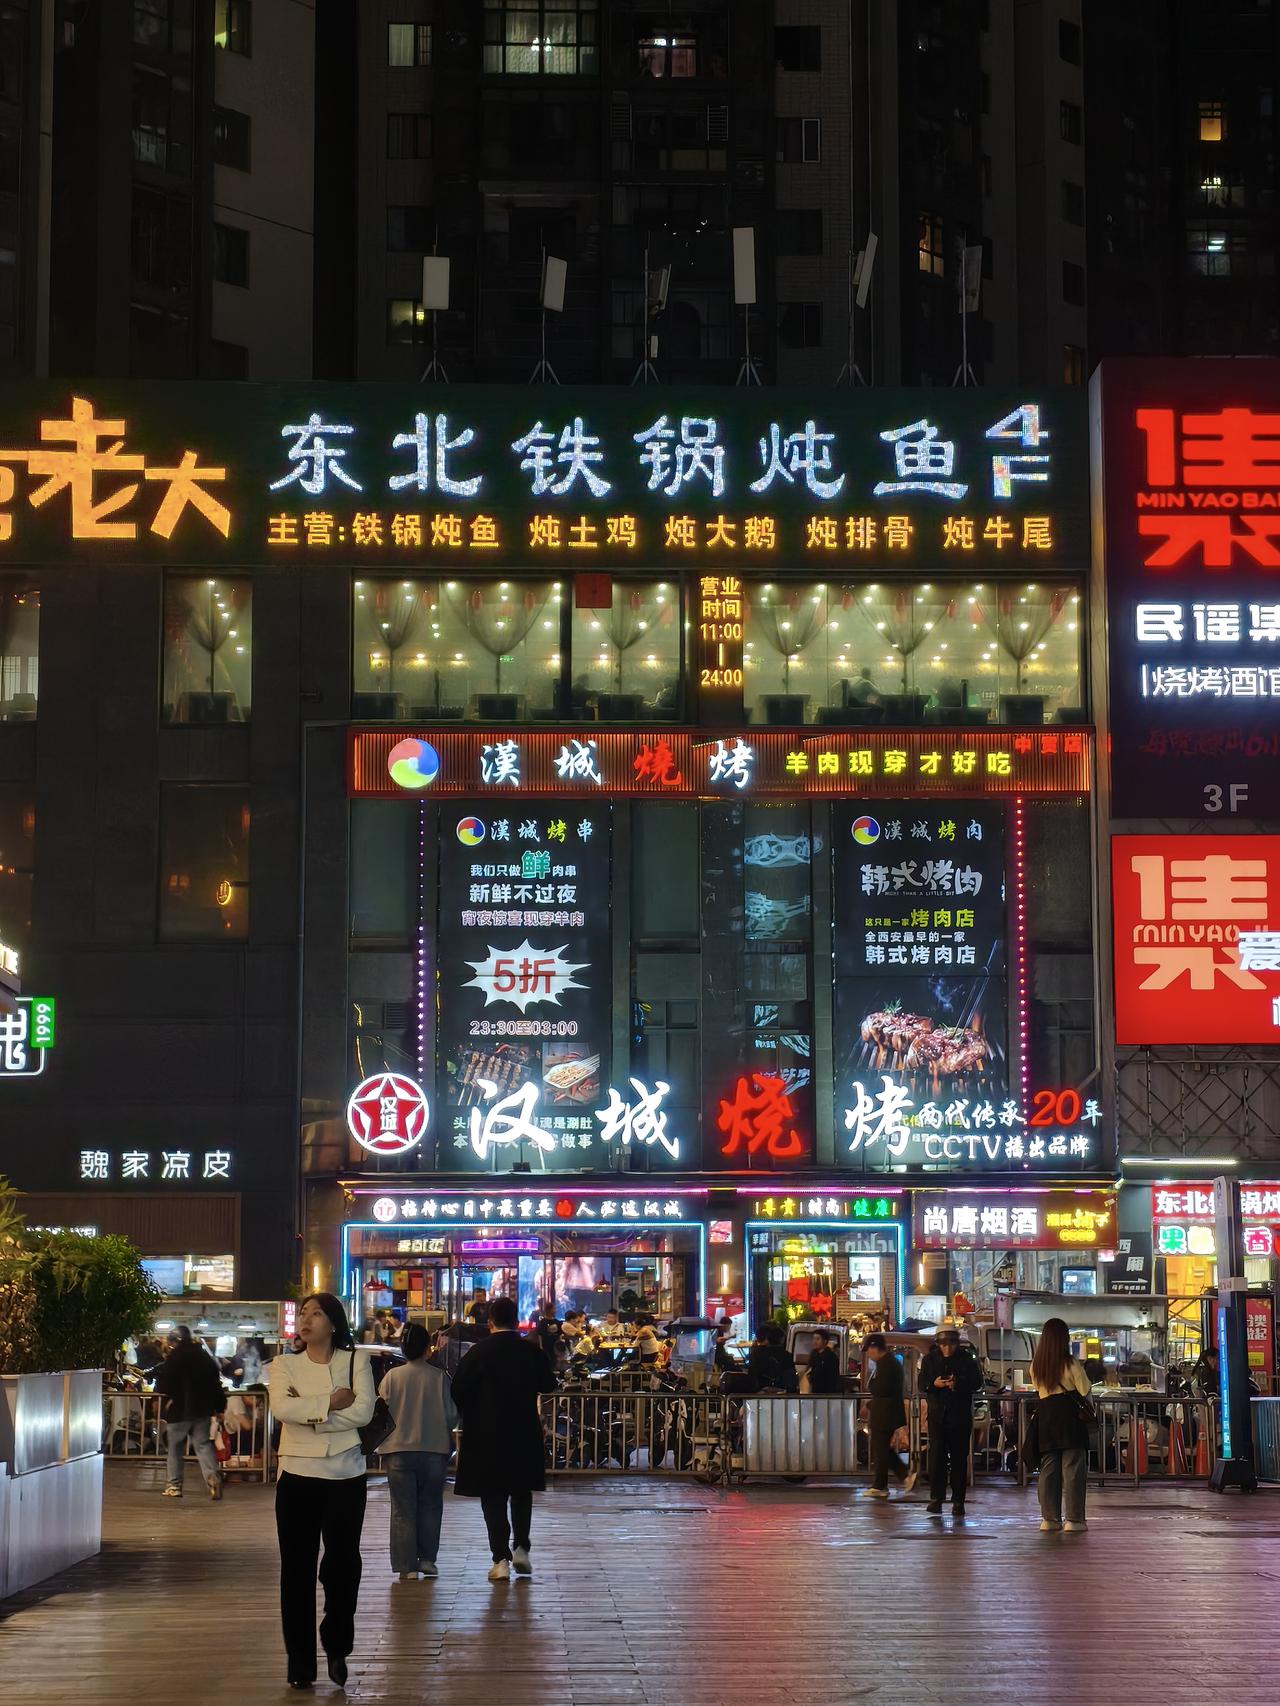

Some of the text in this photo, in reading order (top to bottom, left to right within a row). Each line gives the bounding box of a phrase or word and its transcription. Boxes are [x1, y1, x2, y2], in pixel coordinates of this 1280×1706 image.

[269, 411, 969, 499] 东北铁锅炖鱼
[985, 403, 1050, 498] 4F
[0, 397, 231, 540] 老大
[1137, 493, 1280, 508] MIN YAO BA
[529, 514, 638, 548] 炖土鸡
[665, 515, 776, 549] 炖大鹅
[807, 516, 914, 550] 炖排骨
[943, 516, 1053, 549] 炖牛尾
[700, 576, 741, 597] 营业
[701, 599, 741, 619] 时间
[700, 623, 742, 641] 11:00
[700, 669, 742, 687] 24:00
[786, 750, 1012, 775] 羊肉现穿才好吃
[1203, 783, 1249, 812] 3F
[470, 850, 577, 879] 我们只做鲜肉串
[860, 859, 983, 896] 韩式烤肉
[469, 883, 577, 904] 新鲜不过夜
[865, 931, 965, 943] 全西安最早的一家
[865, 944, 976, 965] 韩式烤肉店
[493, 957, 556, 994] 5折
[36, 1003, 51, 1043] 1999
[80, 1150, 231, 1178] 魏家凉皮
[923, 1206, 1038, 1235] 尚唐烟酒
